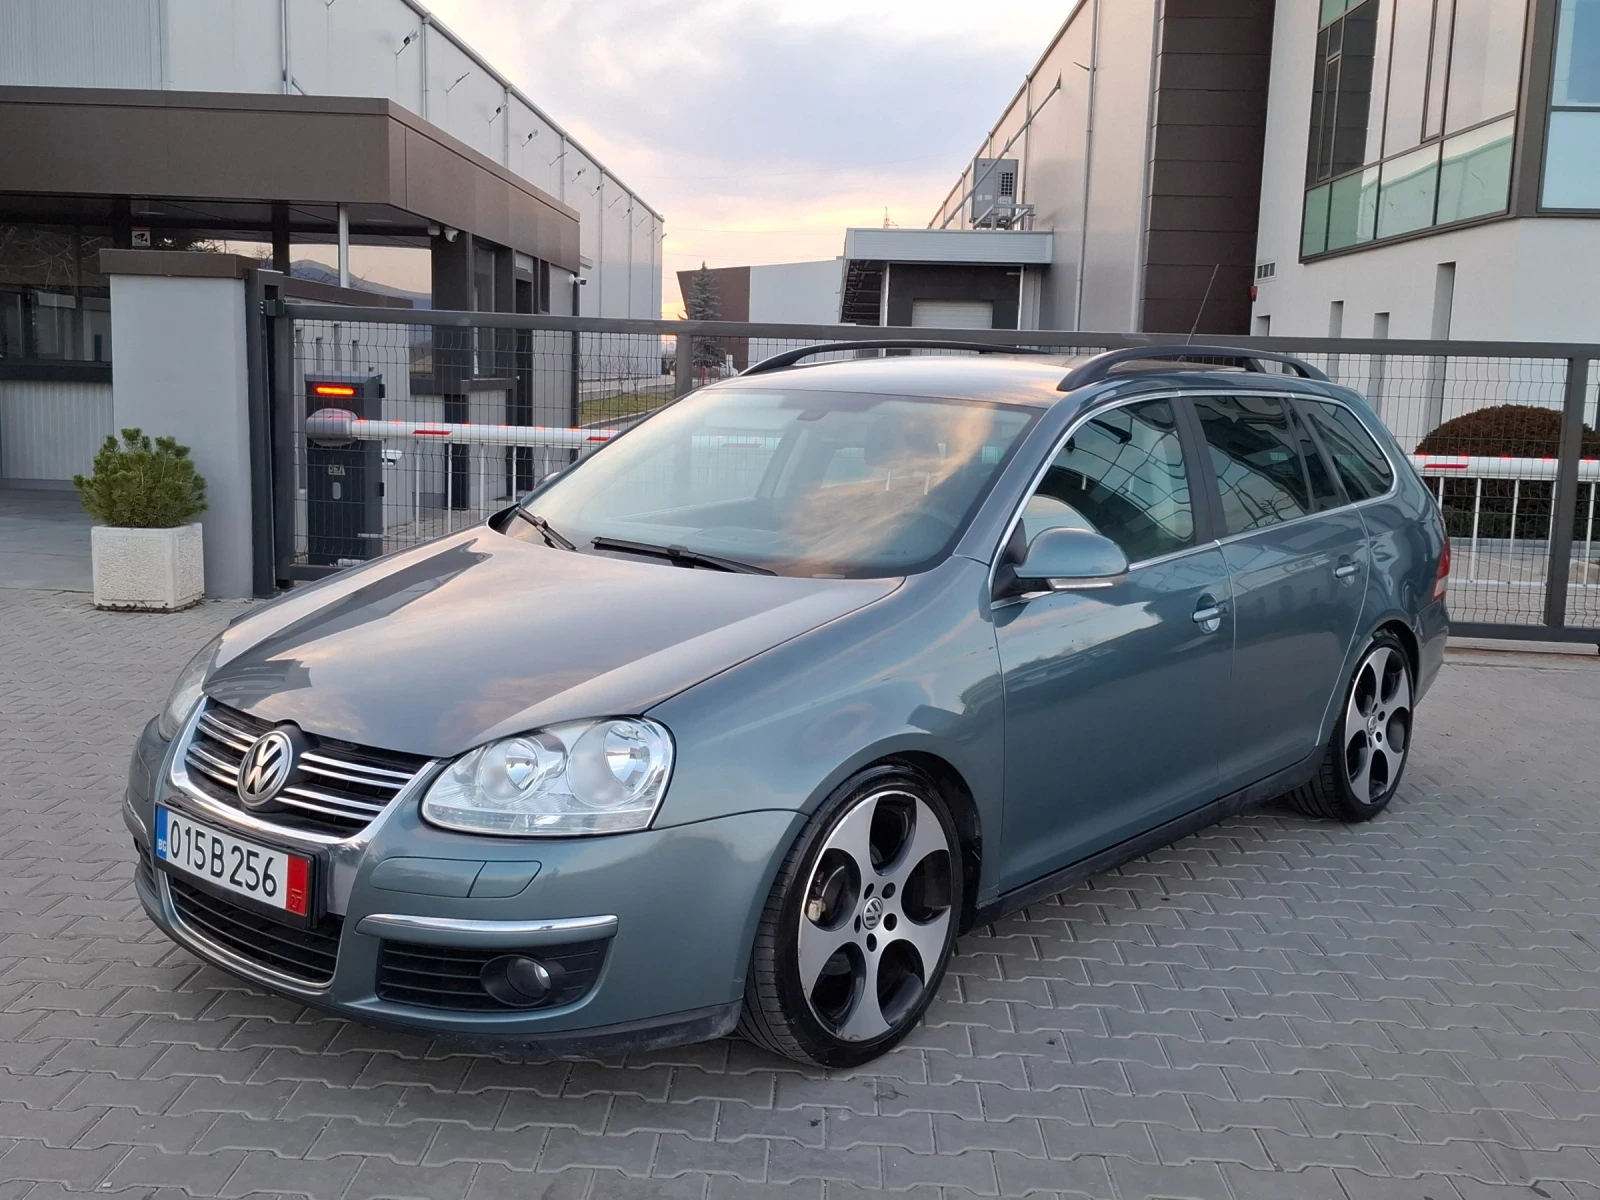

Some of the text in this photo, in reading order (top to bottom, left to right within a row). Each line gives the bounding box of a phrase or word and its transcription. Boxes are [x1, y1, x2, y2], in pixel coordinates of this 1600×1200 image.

[328, 464, 346, 476] DEA
[240, 732, 291, 803] VW
[158, 838, 167, 853] BG
